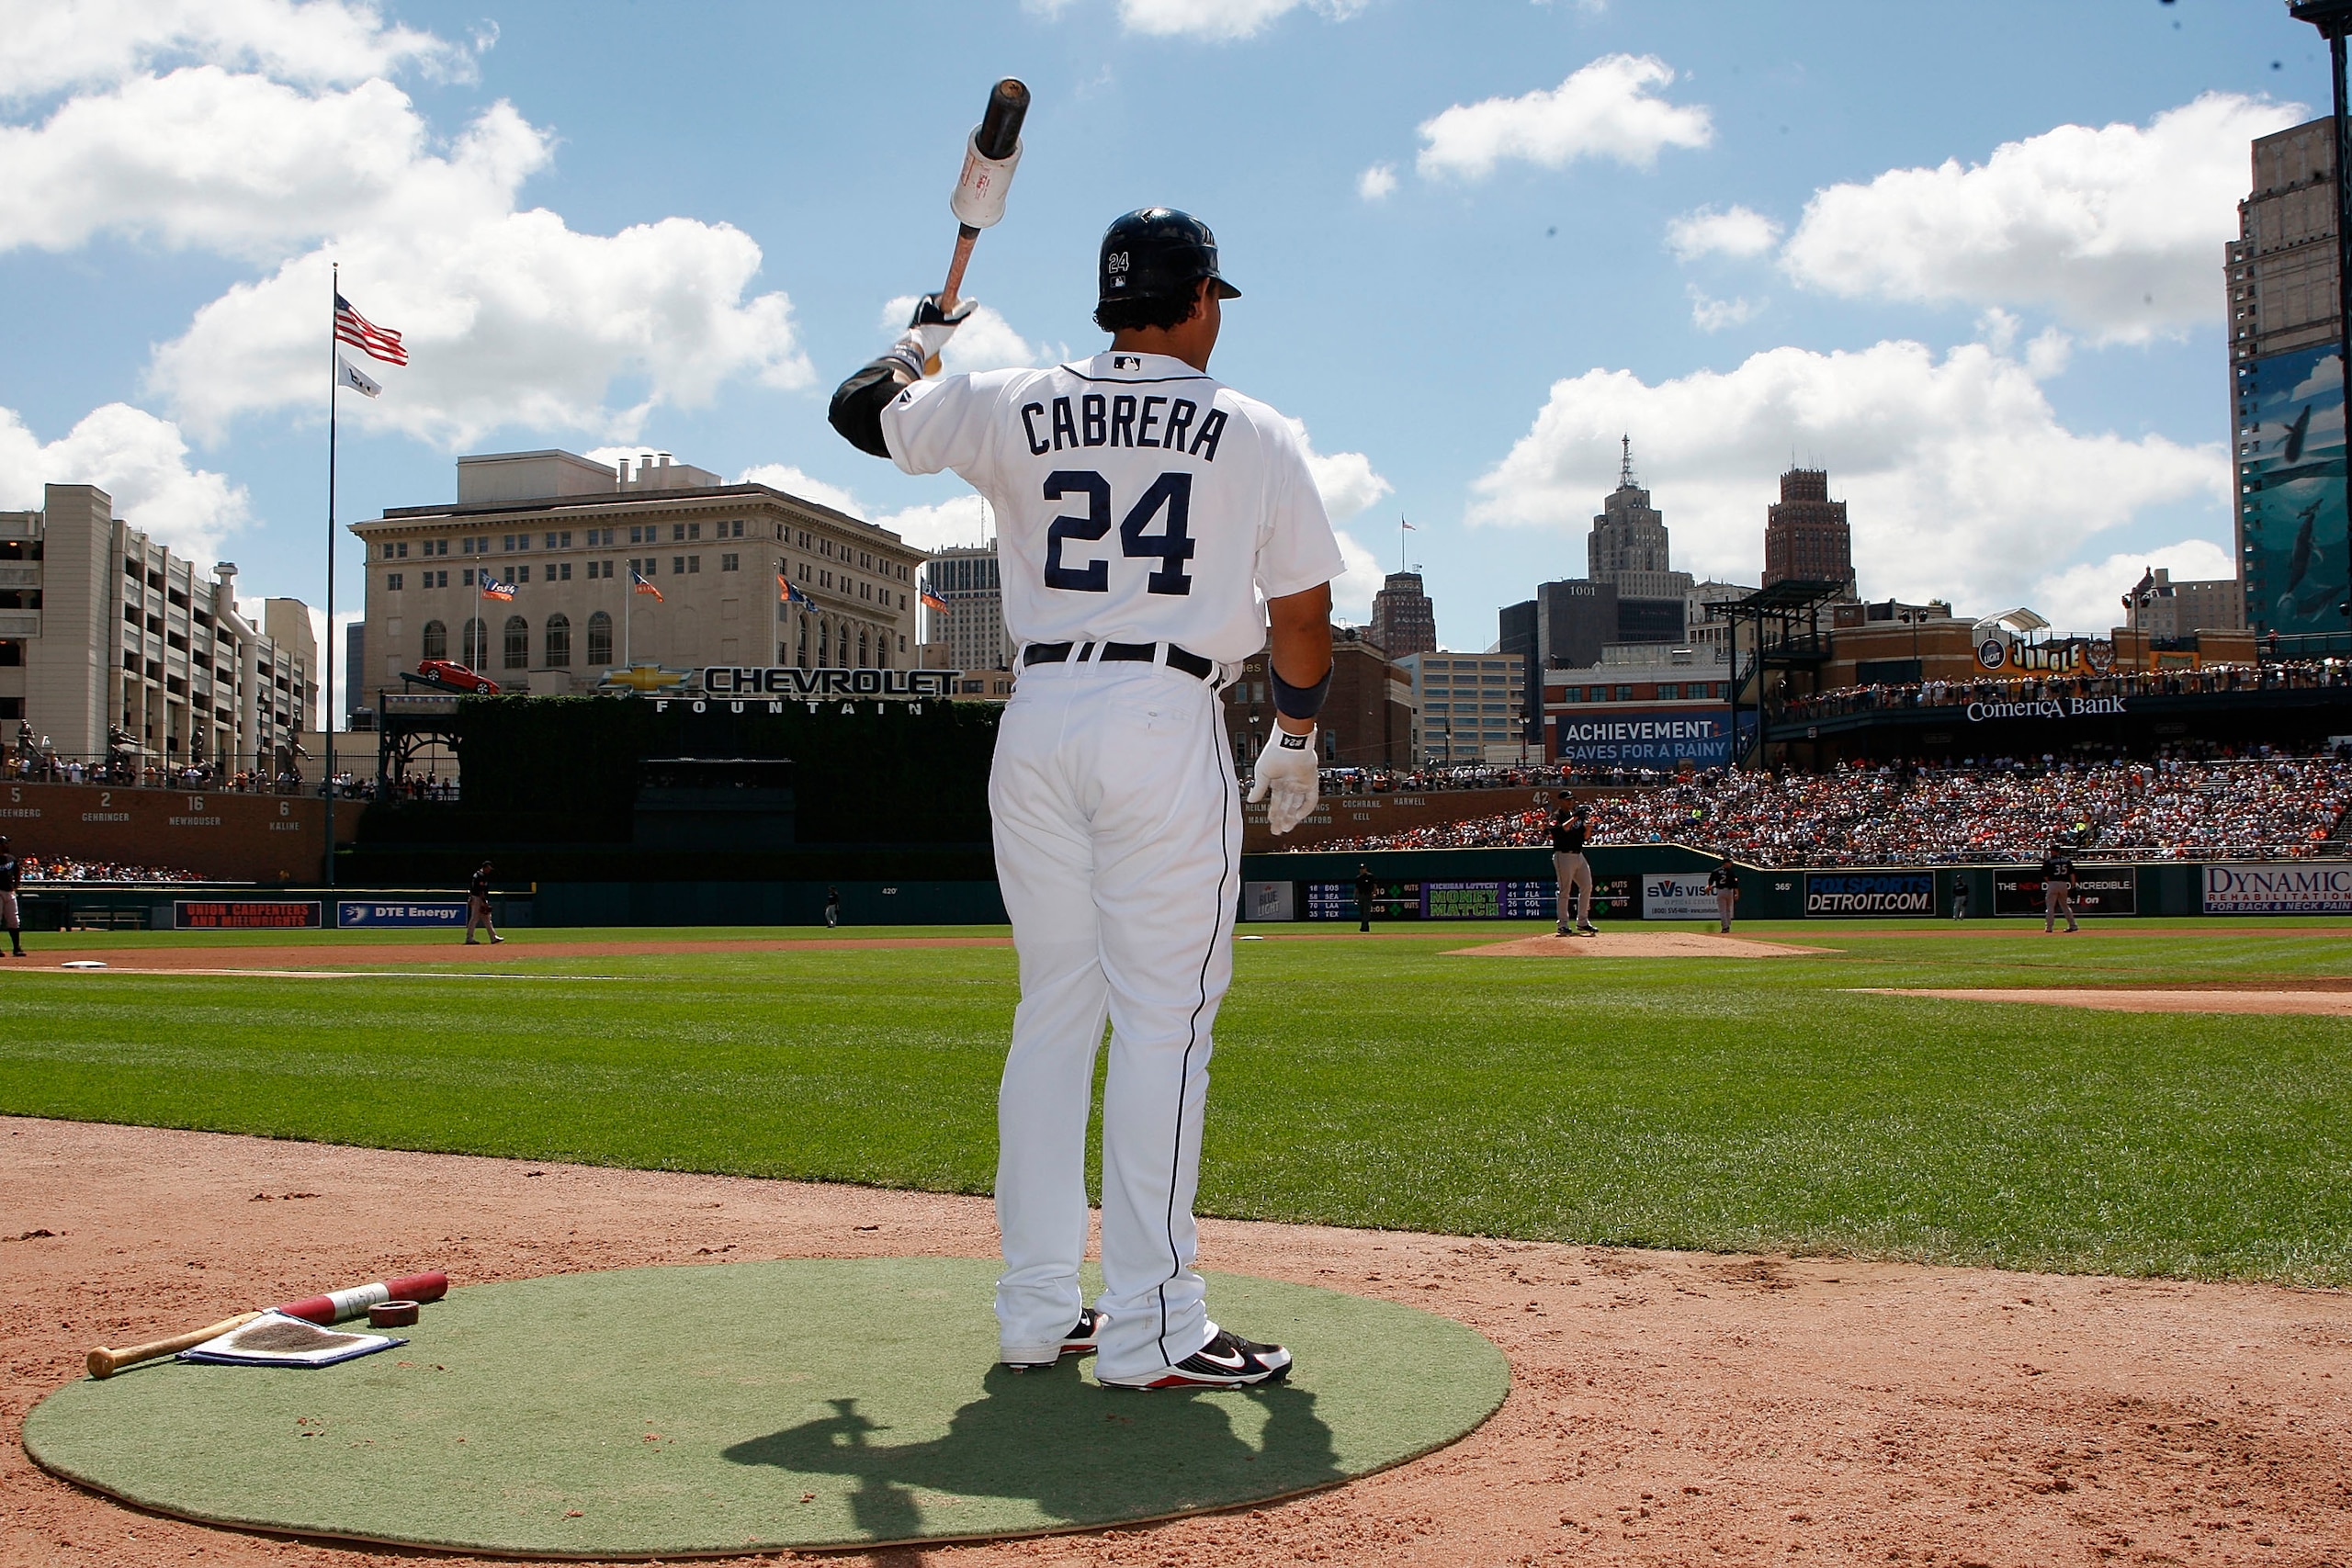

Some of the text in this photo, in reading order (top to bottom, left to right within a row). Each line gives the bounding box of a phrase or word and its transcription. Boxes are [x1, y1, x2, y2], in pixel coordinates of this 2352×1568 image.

[1108, 252, 1129, 274] 24
[1021, 393, 1229, 462] CABRERA
[1043, 470, 1196, 595] 24
[1570, 586, 1595, 596] 1001
[1984, 652, 2001, 664] LIGHT
[2013, 641, 2079, 672] JUNGLE
[1243, 663, 1261, 672] ies
[703, 666, 965, 697] CHEVROLET
[656, 701, 922, 716] FOUNTAIN
[2071, 695, 2127, 716] Bank
[1283, 737, 1304, 747] #24
[1565, 745, 1617, 760] SAVES
[1622, 744, 1654, 759] FOR
[1658, 743, 1670, 758] A
[1674, 742, 1725, 757] RAINY
[11, 787, 21, 803] 5
[101, 792, 111, 807] 2
[1532, 792, 1549, 805] 42
[187, 795, 204, 811] 16
[1342, 799, 1382, 808] COCHRANE
[1394, 797, 1426, 806] HARWELL
[279, 801, 290, 817] 6
[82, 812, 130, 822] GEHRINGER
[169, 817, 220, 826] NEWHOUSER
[1352, 813, 1370, 821] KELL
[269, 822, 300, 830] KALINE
[2053, 865, 2067, 875] 35
[1719, 875, 1726, 884] 2
[1997, 883, 2017, 891] THE
[2018, 882, 2041, 891] NEW
[2075, 881, 2132, 890] NCREDIBLE.
[1260, 891, 1278, 906] BLUE
[1430, 889, 1498, 903] MONEY
[1807, 893, 1929, 910] DETROIT.COM
[2209, 893, 2352, 901] REHABILITATION
[187, 904, 309, 916] UNION CARPENTERS
[1258, 901, 1279, 917] LIGHT
[1430, 902, 1498, 916] MATCH
[2211, 902, 2234, 910] FOR
[2238, 902, 2271, 910] BACK
[2274, 902, 2282, 910] &
[375, 908, 458, 919] DTE Energy
[190, 916, 306, 927] AND MILLWRIGHTS
